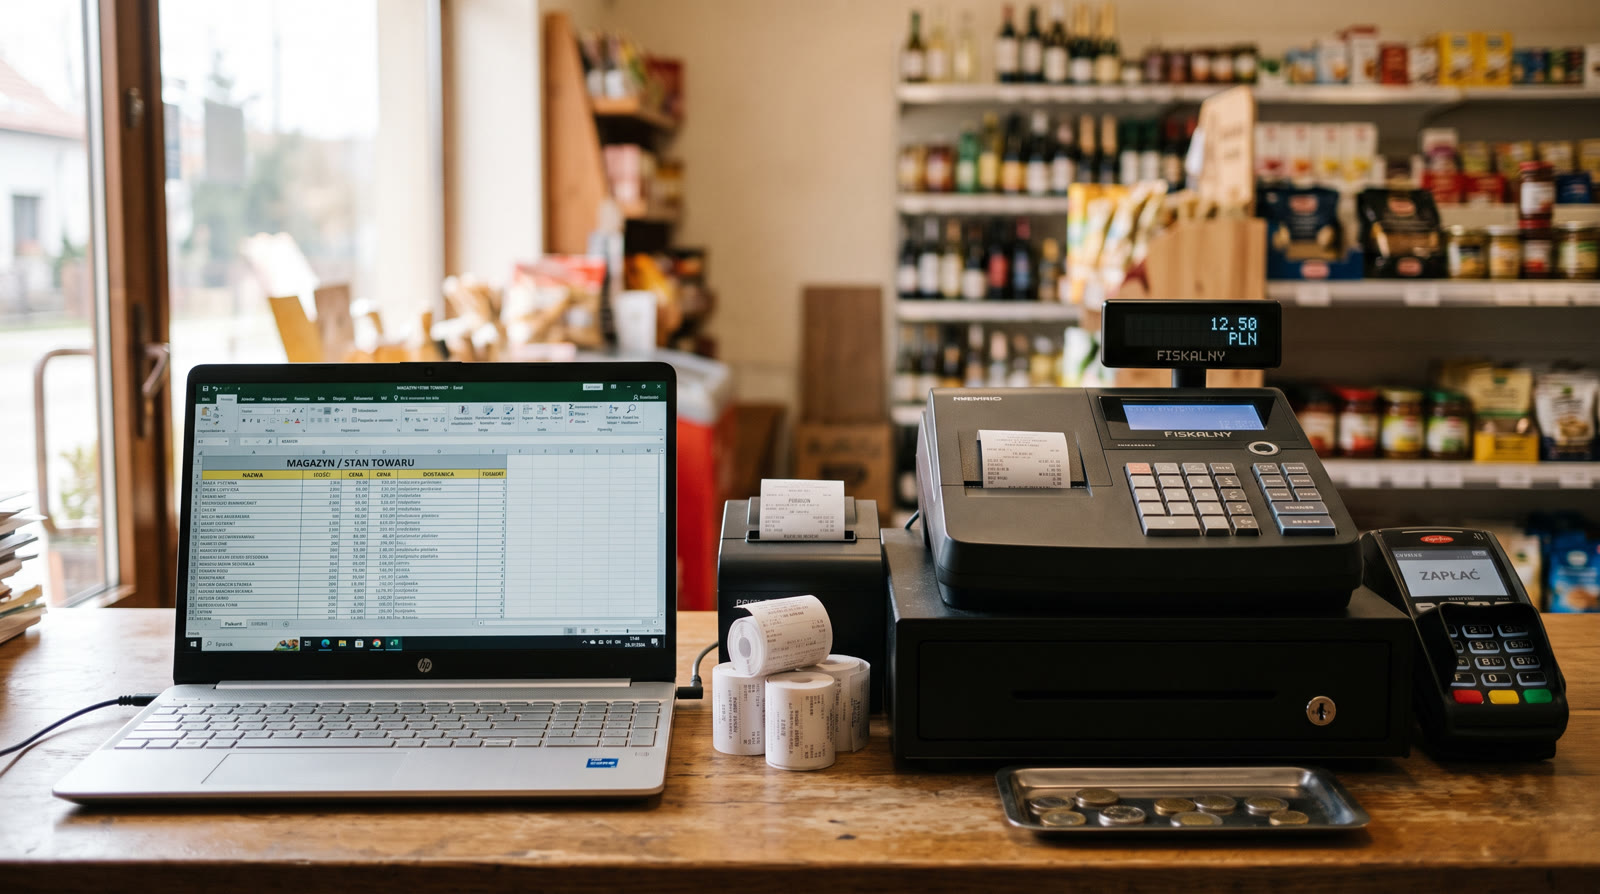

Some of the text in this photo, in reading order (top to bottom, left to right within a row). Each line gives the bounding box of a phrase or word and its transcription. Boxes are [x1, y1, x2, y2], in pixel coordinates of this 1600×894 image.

[1211, 317, 1257, 331] 12.50
[1228, 332, 1257, 346] PLN
[1157, 350, 1226, 362] FISKALNY
[286, 458, 414, 468] MAGAZYN / STAN TOWARU
[1419, 568, 1480, 580] ZAPŁAĆ
[417, 658, 432, 672] hp
